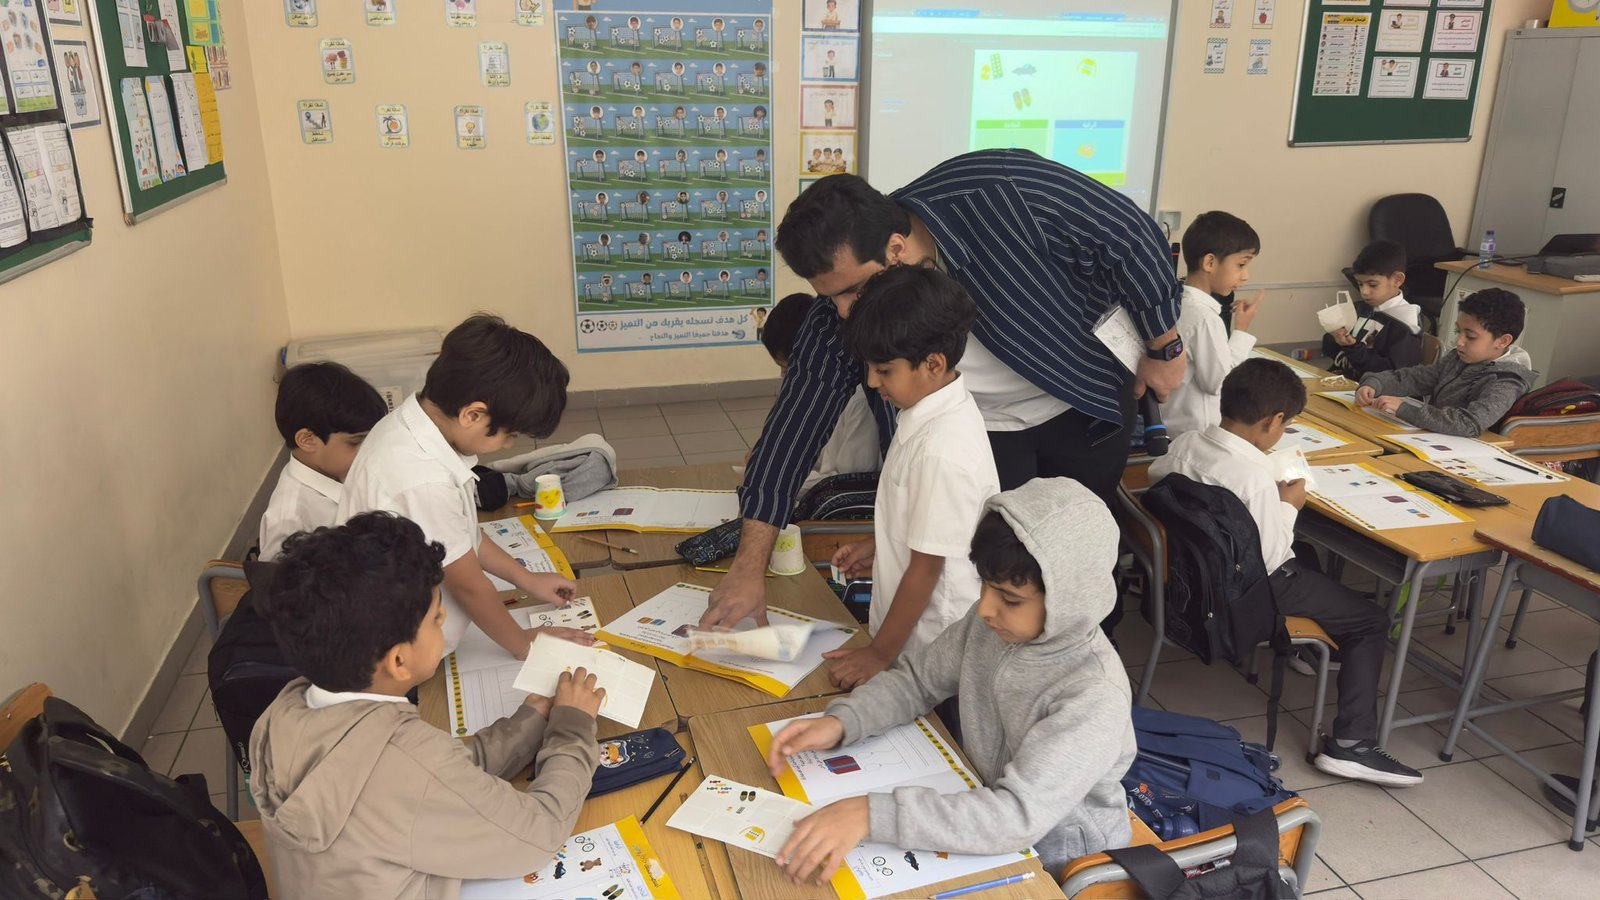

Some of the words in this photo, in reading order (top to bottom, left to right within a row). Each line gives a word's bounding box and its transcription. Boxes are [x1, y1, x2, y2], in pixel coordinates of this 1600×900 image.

[660, 318, 683, 328] يقربك
[686, 317, 713, 325] نسجله
[737, 314, 748, 325] كل
[620, 319, 643, 330] التميز
[645, 320, 658, 329] من
[650, 332, 672, 341] والنجاح
